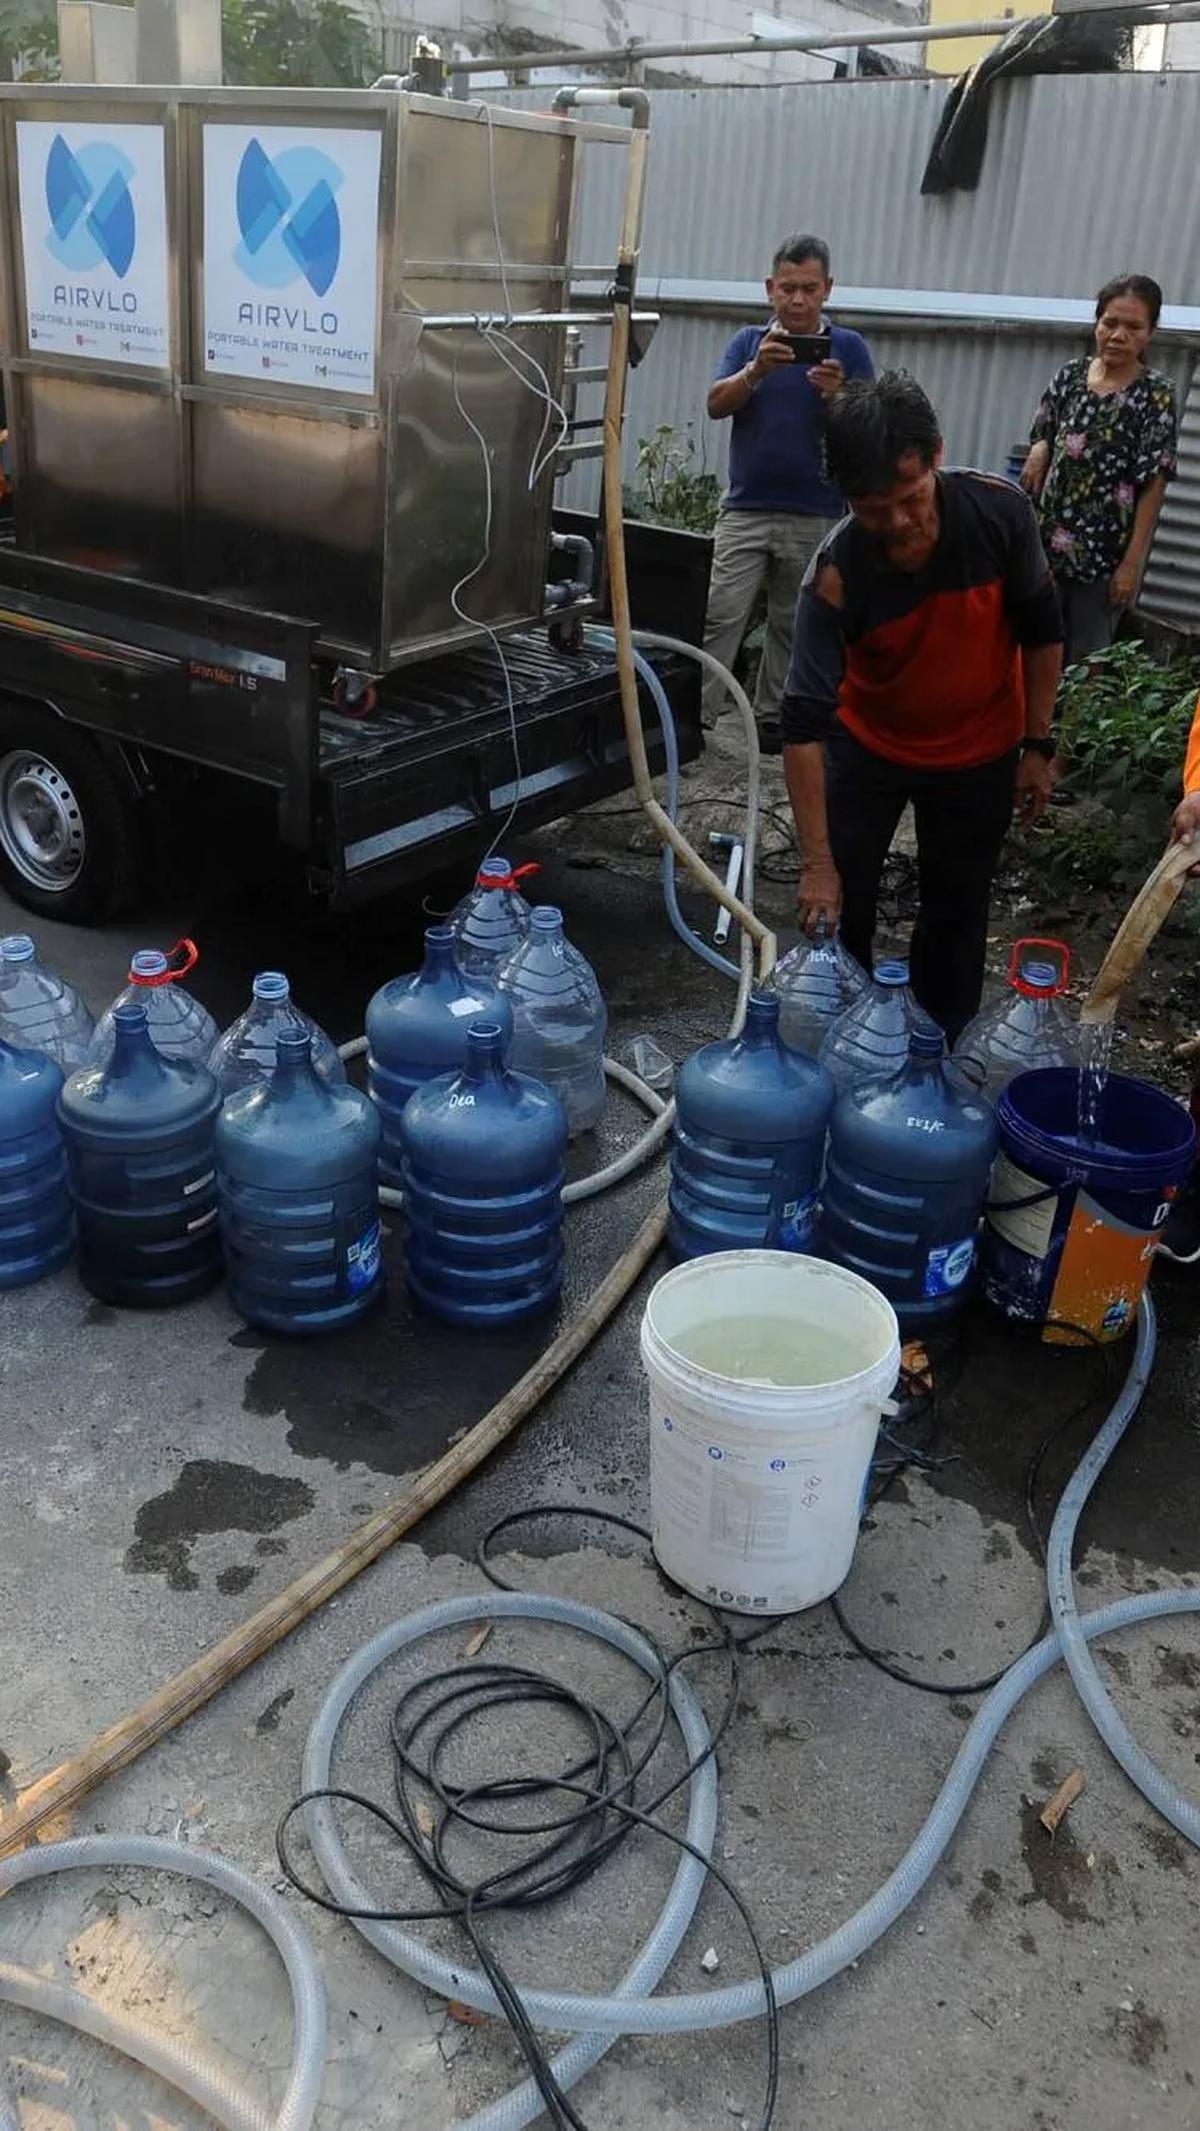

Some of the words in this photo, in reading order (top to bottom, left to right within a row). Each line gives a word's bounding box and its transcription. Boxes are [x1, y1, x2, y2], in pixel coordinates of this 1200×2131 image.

[54, 285, 137, 313] AIRVLO
[239, 302, 338, 335] AIRVLO
[207, 331, 259, 348] PORTABLE
[262, 339, 299, 352] WATER
[302, 344, 369, 363] TREATMENT
